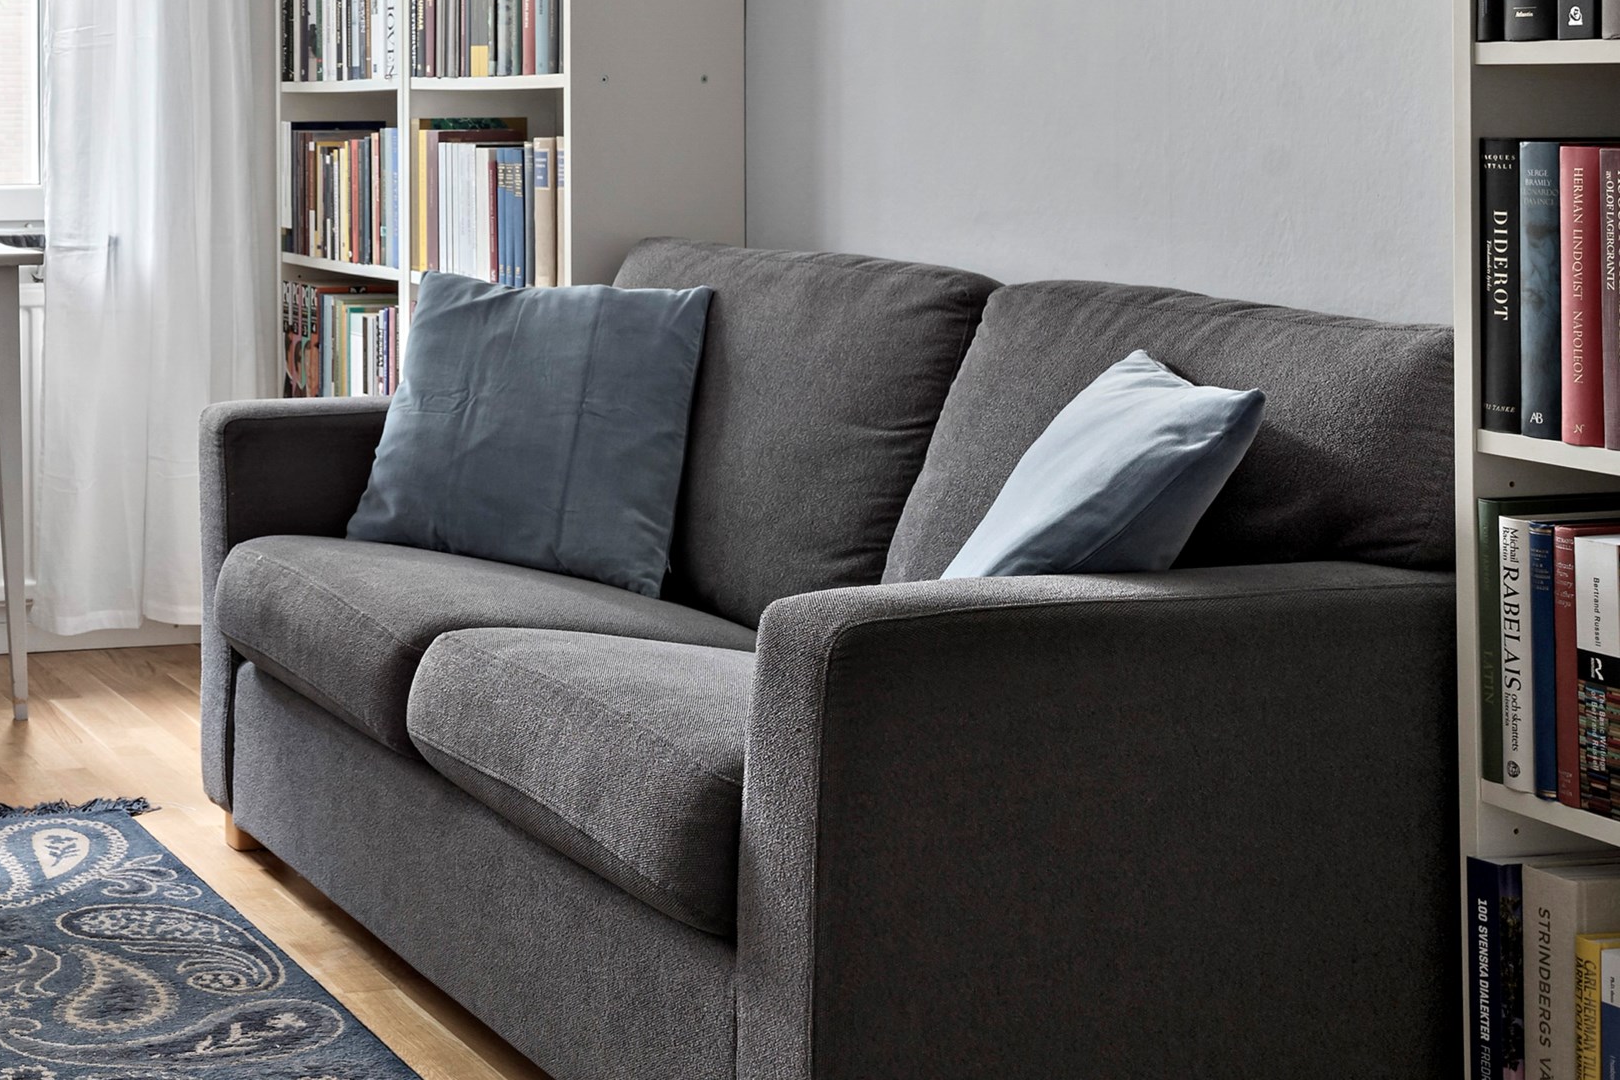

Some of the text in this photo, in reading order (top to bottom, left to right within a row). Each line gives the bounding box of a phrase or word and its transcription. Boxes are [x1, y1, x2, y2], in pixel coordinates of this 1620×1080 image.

[1606, 180, 1615, 210] OLOF
[1493, 210, 1508, 322] DIDEROT
[1606, 212, 1615, 290] LAGERCRANTZ
[1572, 167, 1584, 384] HERMAN LINDQVIST NAPOLEON
[1502, 526, 1522, 751] Michail RABELAIS och skrattets
[1594, 616, 1602, 647] Russell
[1483, 650, 1494, 706] LATIN
[1504, 692, 1512, 726] historia
[1590, 700, 1599, 738] Bertrand
[1598, 710, 1606, 734] Basic
[1590, 740, 1599, 771] Russell
[1598, 735, 1607, 771] Writings
[1478, 898, 1488, 922] 100
[1478, 924, 1488, 977] SVENSKA
[1538, 906, 1552, 1048] STRINDBERGS
[1480, 979, 1490, 1041] DIALEKTER
